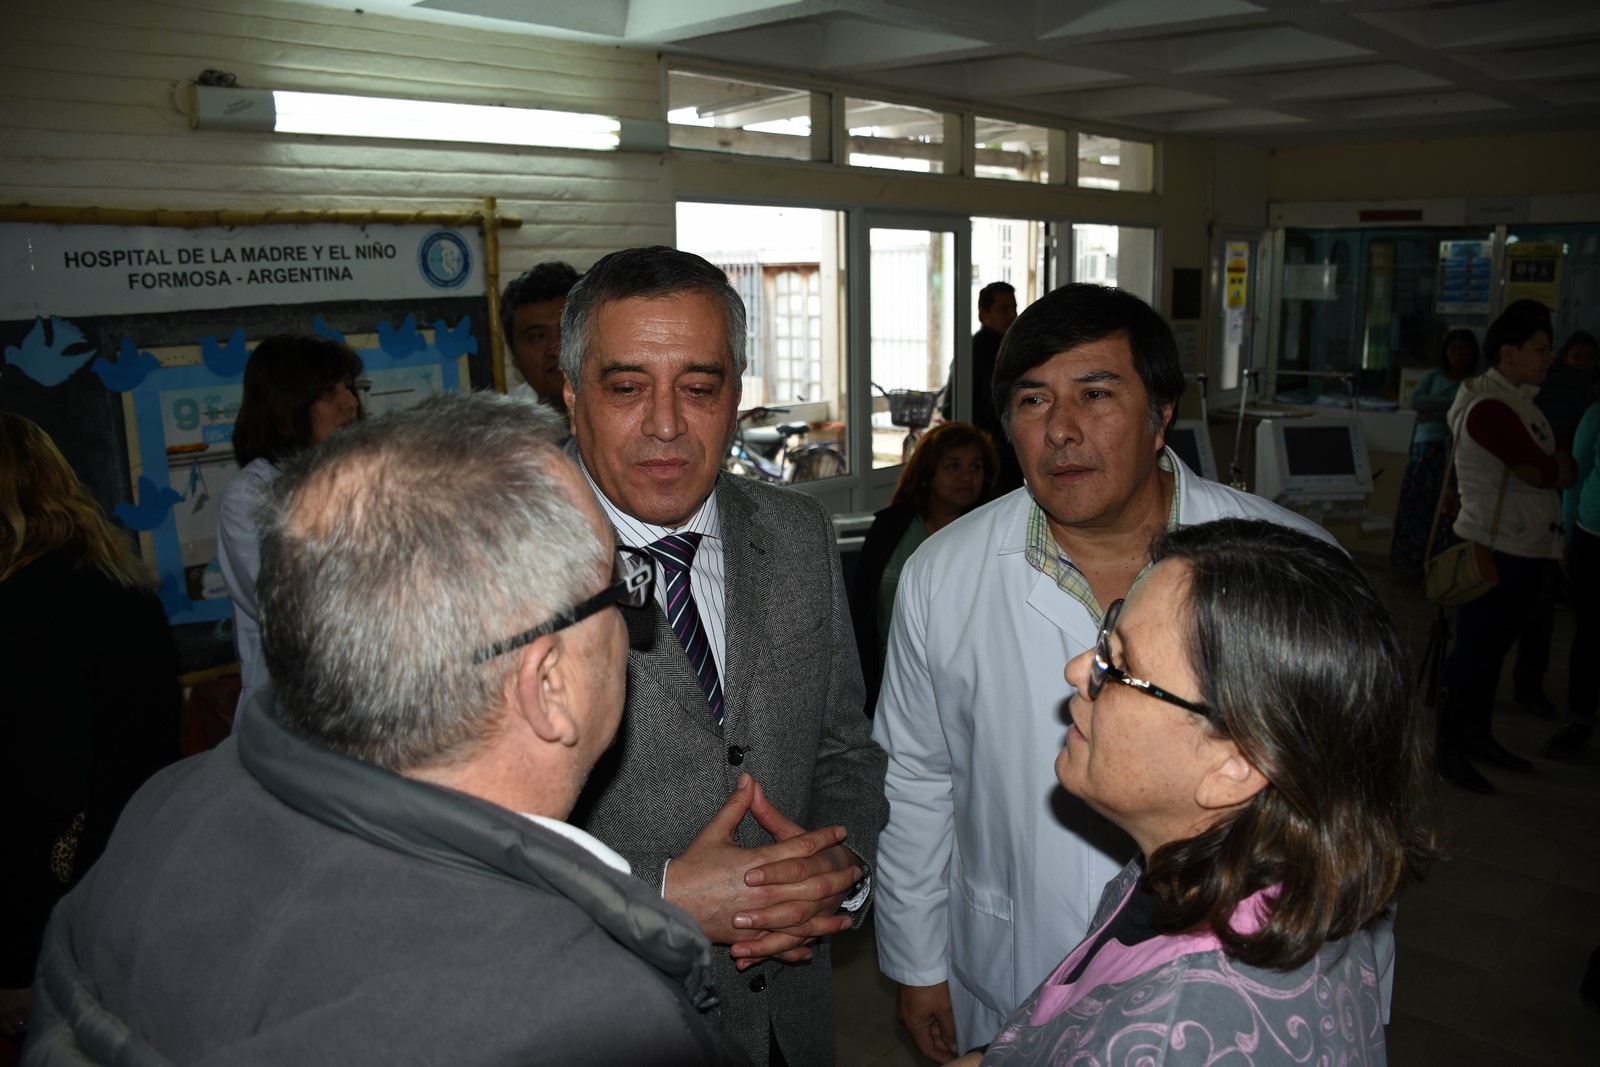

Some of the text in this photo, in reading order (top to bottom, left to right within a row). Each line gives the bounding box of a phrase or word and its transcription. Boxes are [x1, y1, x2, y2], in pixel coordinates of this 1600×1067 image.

[64, 241, 397, 268] HOSPITAL DE LA MADRE Y EL NIÑO
[128, 270, 232, 290] FORMOSA
[247, 266, 354, 285] ARGENTINA
[173, 398, 200, 431] 9
